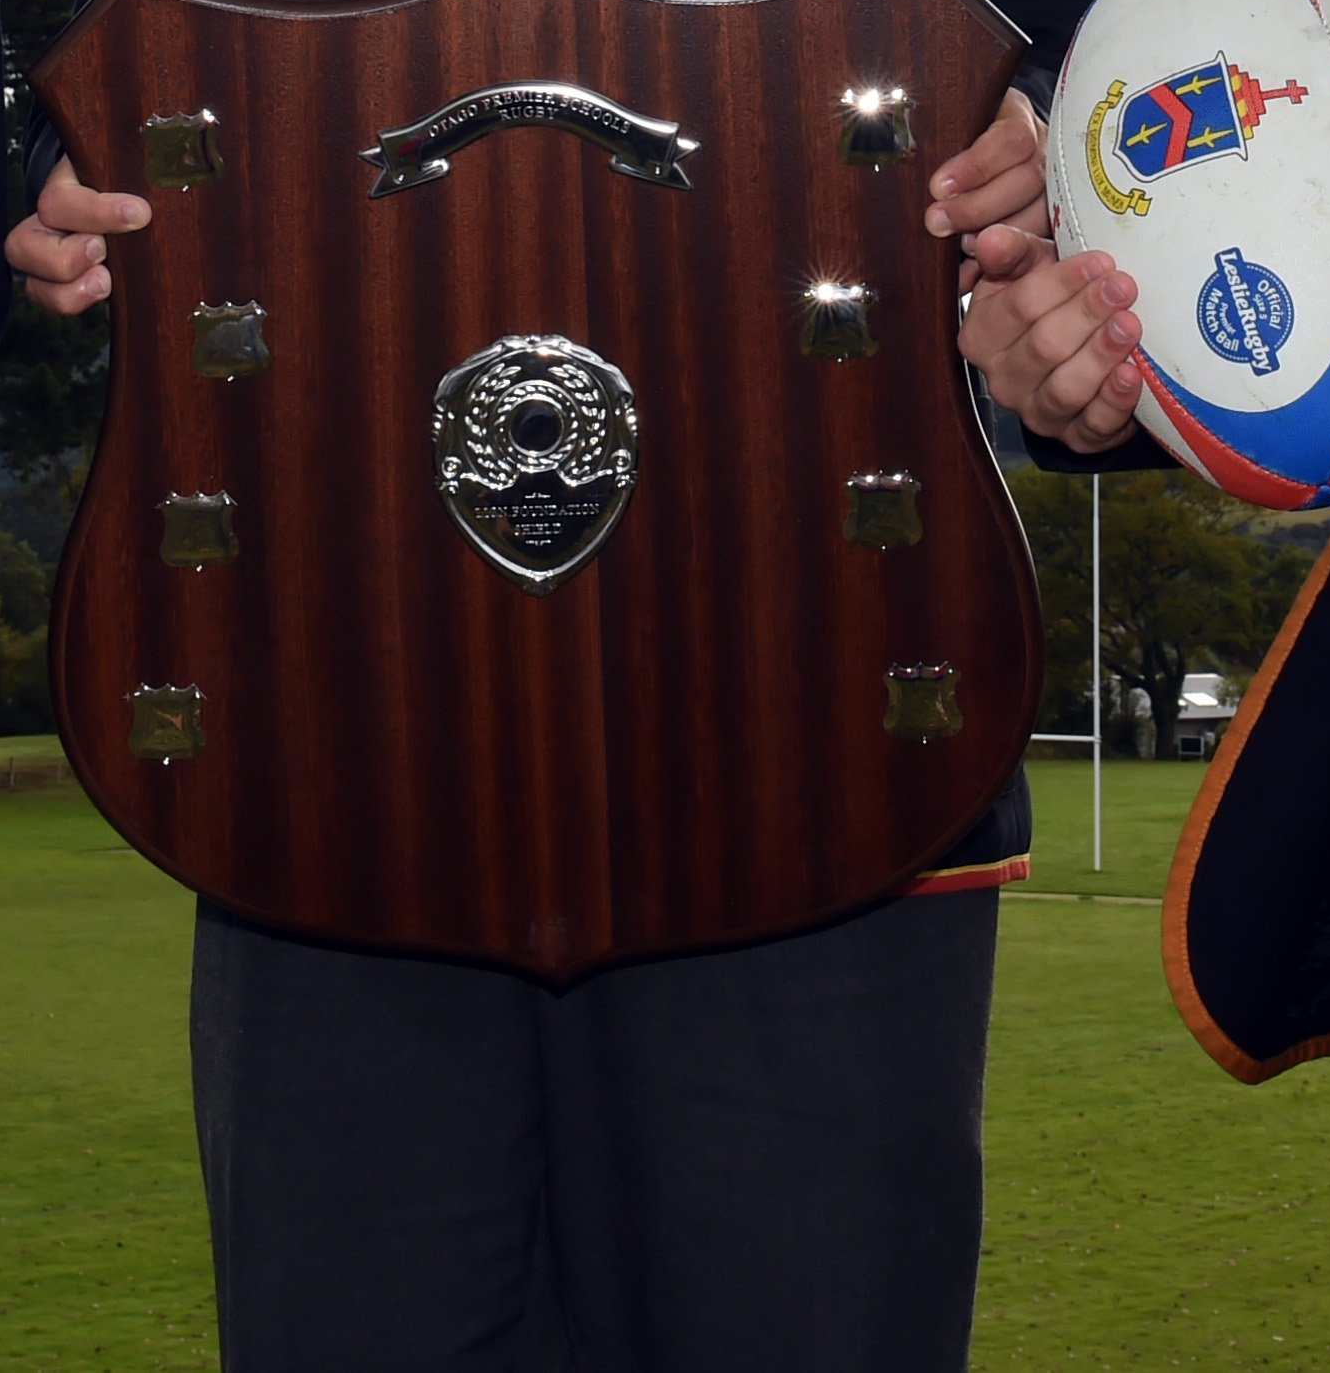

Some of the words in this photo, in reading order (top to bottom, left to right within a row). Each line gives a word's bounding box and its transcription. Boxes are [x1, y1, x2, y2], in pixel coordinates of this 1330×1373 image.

[428, 104, 479, 138] OTAGO
[481, 90, 556, 112] PREMIER
[559, 94, 632, 135] SCHOOLS
[498, 105, 560, 121] RUGBY
[1206, 287, 1224, 333] Match
[1215, 330, 1240, 352] Ball
[1219, 251, 1273, 371] LeslieRugby
[1252, 293, 1266, 312] Size
[1257, 279, 1284, 330] Official
[511, 503, 600, 517] FOUNDATION
